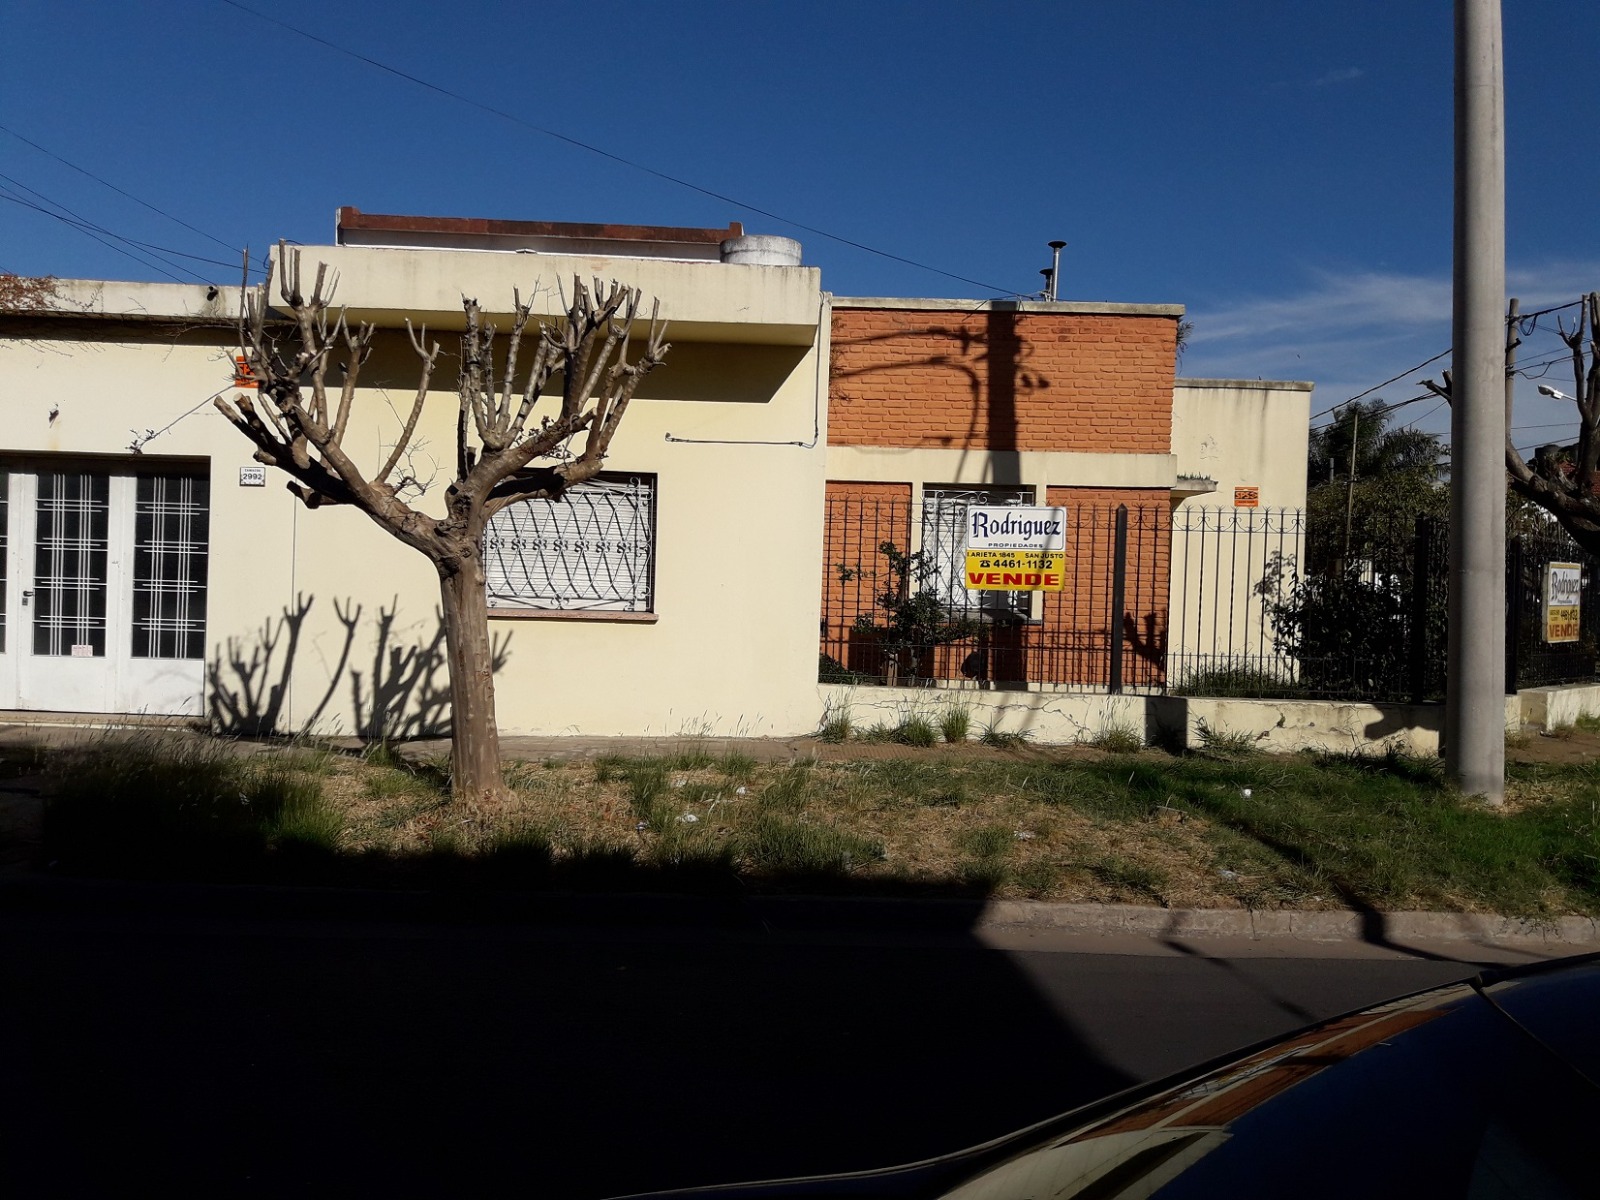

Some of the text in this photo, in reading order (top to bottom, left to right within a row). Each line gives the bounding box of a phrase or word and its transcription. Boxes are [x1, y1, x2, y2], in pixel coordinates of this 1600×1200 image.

[971, 511, 1061, 541] Rodriguez
[993, 559, 1052, 569] 4461-1132
[968, 572, 1059, 586] VENDE
[1549, 623, 1579, 638] VENDE
